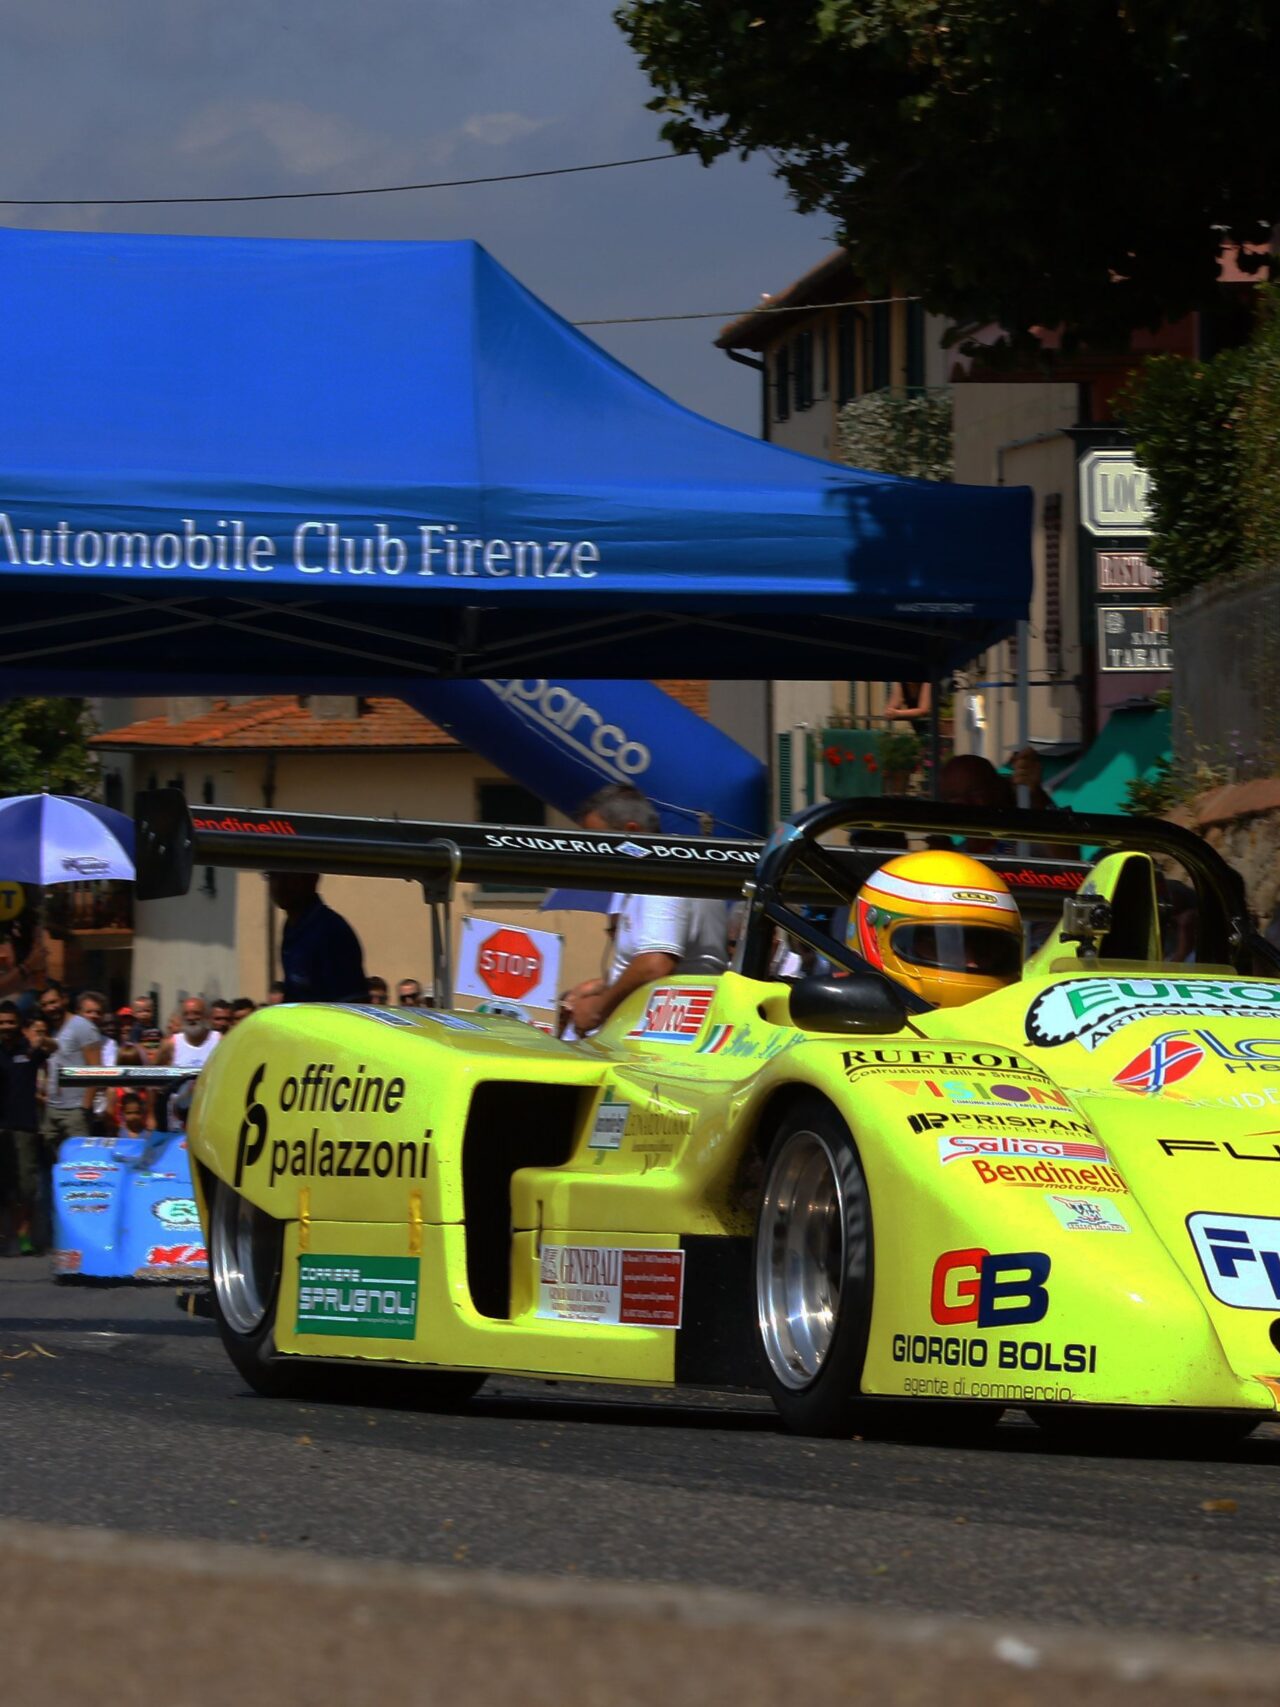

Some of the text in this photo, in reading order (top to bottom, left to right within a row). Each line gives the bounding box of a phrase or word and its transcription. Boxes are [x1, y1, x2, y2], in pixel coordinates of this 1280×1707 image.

[293, 521, 408, 575] Club
[418, 524, 600, 578] Firenze
[496, 679, 650, 774] parco
[192, 816, 297, 836] endinelli
[485, 834, 761, 864] SCUDERIA BOLOGN
[480, 949, 541, 978] STOP
[1091, 1008, 1206, 1050] ARTICOLI
[279, 1063, 406, 1113] officine
[849, 1067, 935, 1083] Costruzioni
[940, 1068, 972, 1077] Edili
[269, 1127, 434, 1188] palazzoni
[972, 1159, 1129, 1189] Bendinelli
[1044, 1183, 1129, 1195] motorsport
[560, 1248, 621, 1286] GENERALI
[930, 1247, 1052, 1329] GB
[892, 1334, 1097, 1374] GIORGIO BOLSI
[903, 1376, 1072, 1402] agente di commercio
